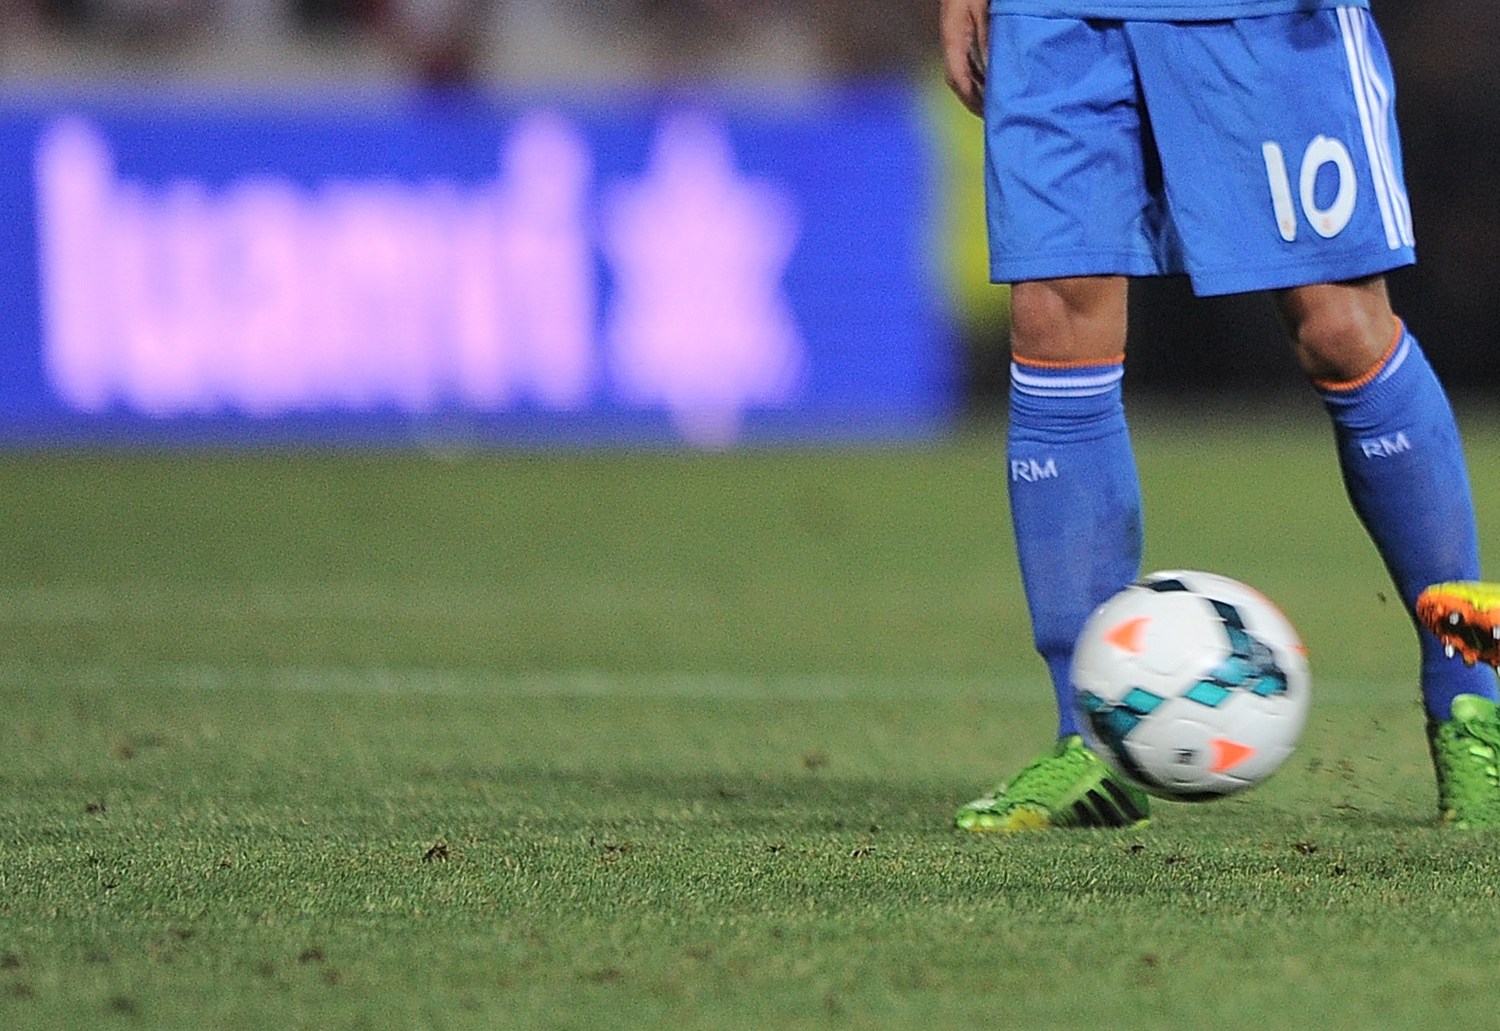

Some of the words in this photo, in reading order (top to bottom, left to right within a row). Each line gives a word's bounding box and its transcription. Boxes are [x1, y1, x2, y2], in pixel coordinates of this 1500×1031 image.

[1262, 134, 1358, 242] 10
[1360, 431, 1411, 458] RM
[1011, 458, 1059, 482] RM
